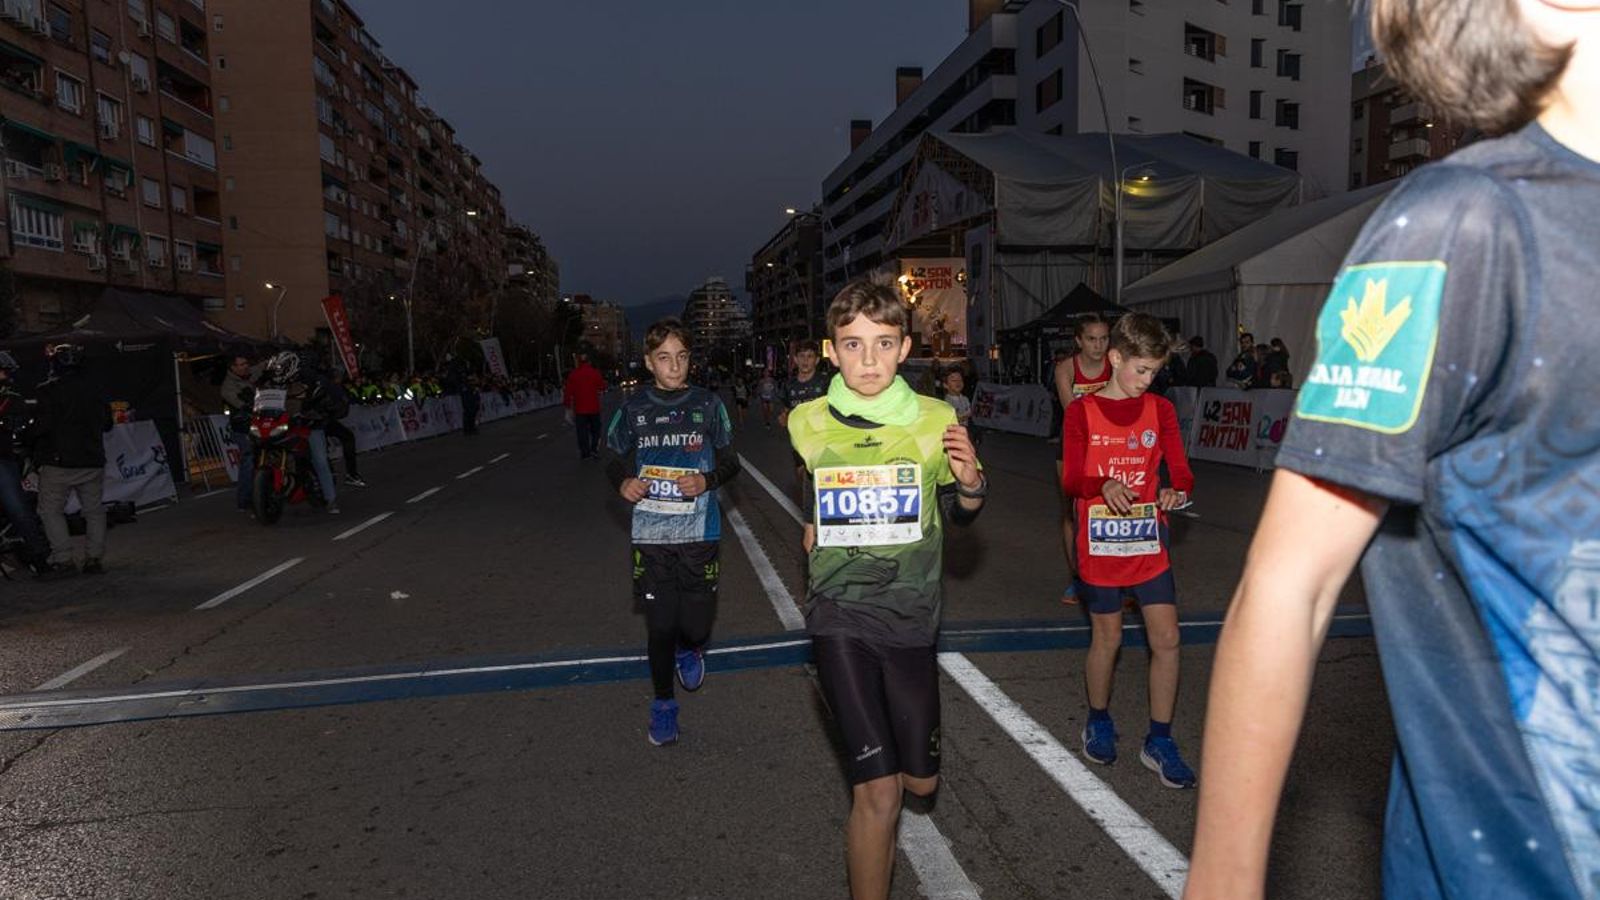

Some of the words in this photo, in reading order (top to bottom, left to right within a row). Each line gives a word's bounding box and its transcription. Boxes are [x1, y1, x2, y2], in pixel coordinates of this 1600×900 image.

[927, 267, 952, 277] SAN
[1203, 400, 1221, 422] 42
[1222, 401, 1252, 425] SAN
[638, 435, 659, 449] SAN
[662, 431, 703, 447] ANTÓN
[1198, 424, 1249, 451] ANTON
[836, 471, 856, 485] 42
[820, 488, 918, 516] 10857
[1091, 519, 1156, 537] 10877
